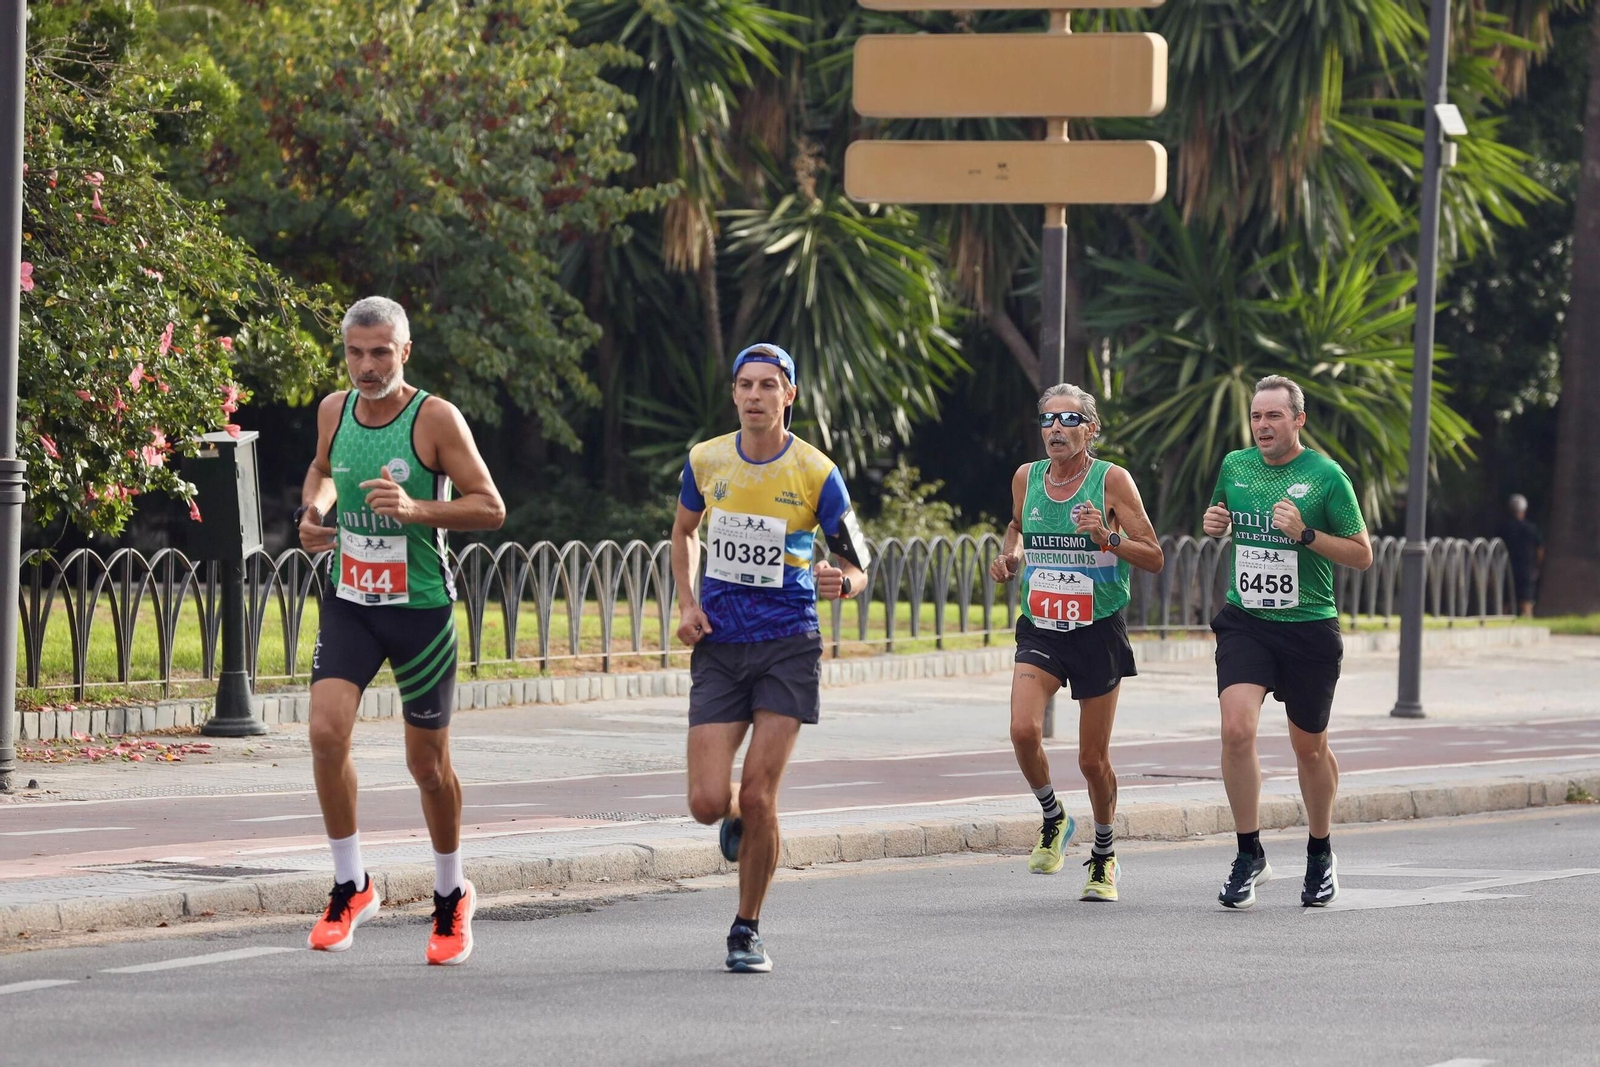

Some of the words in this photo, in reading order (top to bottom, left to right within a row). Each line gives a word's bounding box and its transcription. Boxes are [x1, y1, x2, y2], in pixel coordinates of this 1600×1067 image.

[1031, 535, 1086, 548] ATLETISMO
[1236, 531, 1297, 545] ATLETISMO
[712, 538, 782, 566] 10382
[350, 565, 393, 593] 144
[1240, 572, 1293, 594] 6458
[1040, 597, 1080, 621] 118
